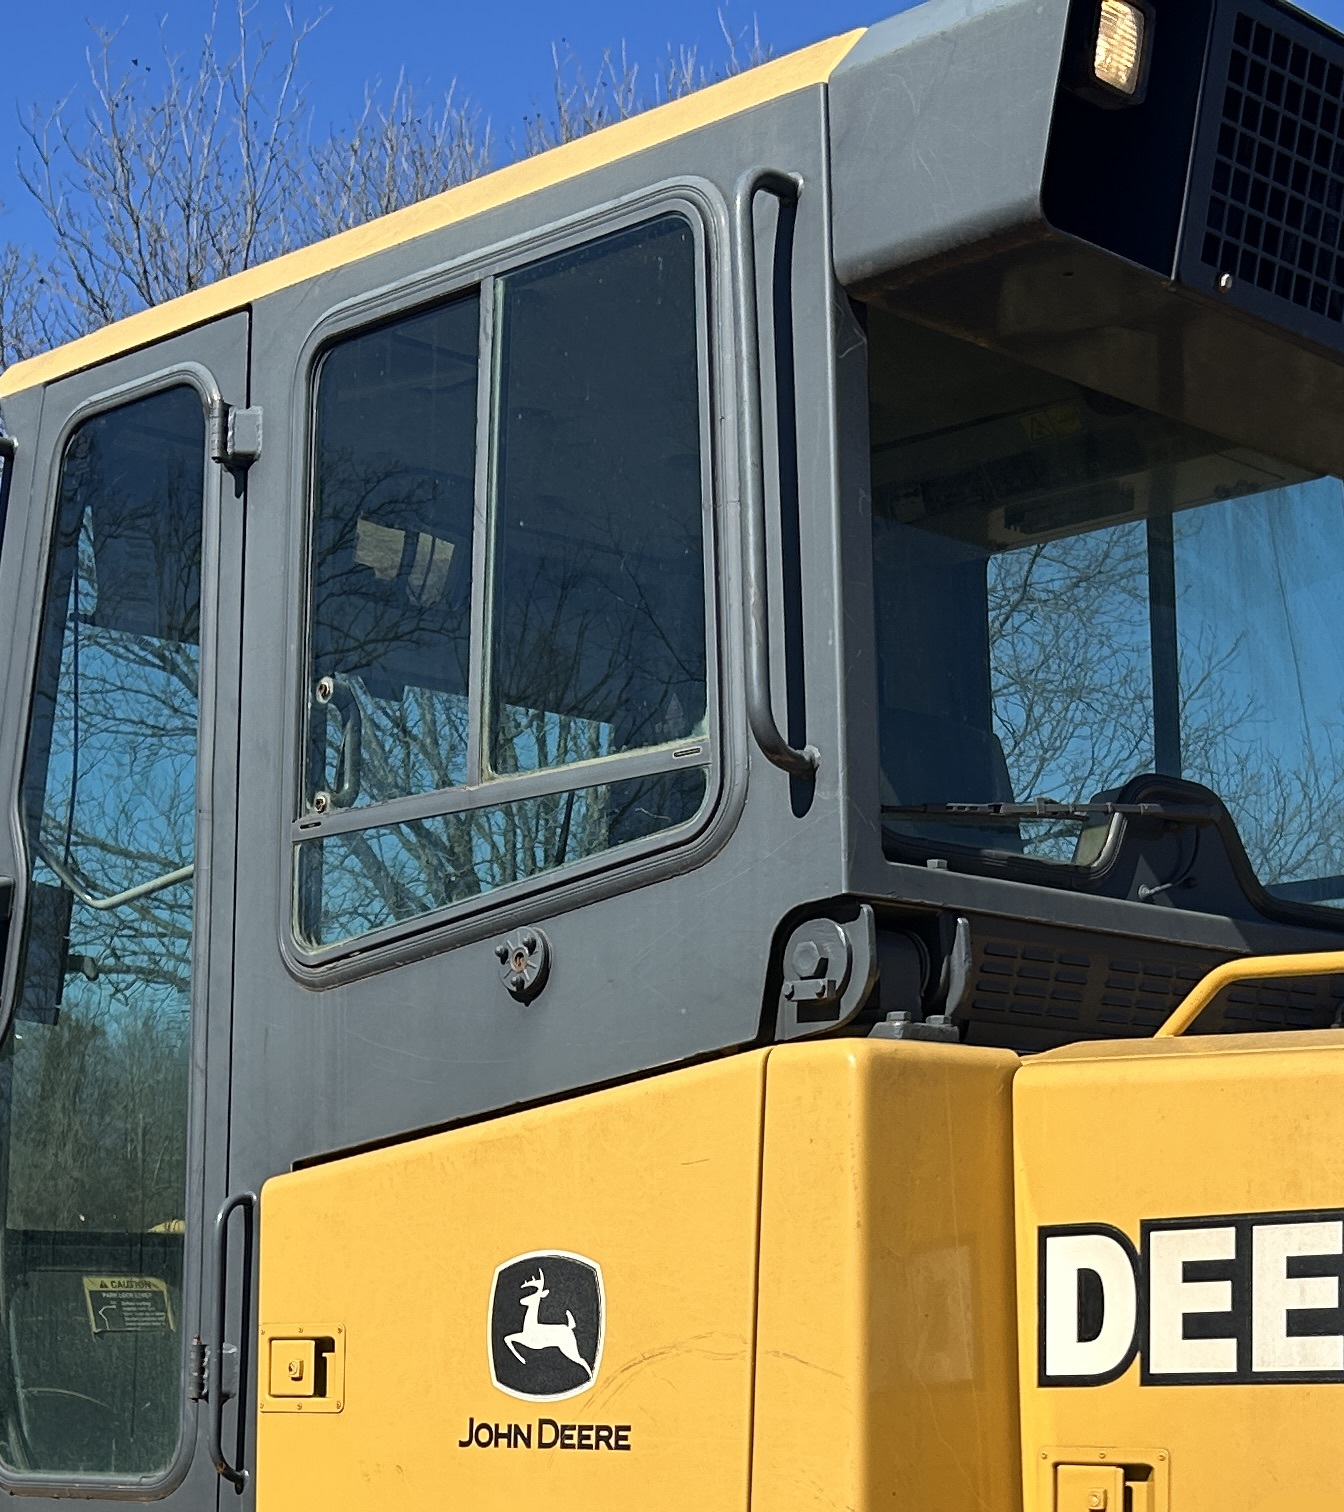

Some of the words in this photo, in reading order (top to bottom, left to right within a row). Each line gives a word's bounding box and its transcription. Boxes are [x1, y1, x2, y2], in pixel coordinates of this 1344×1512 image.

[110, 1281, 152, 1289] CAUTION
[458, 1417, 532, 1449] JOHN
[538, 1418, 632, 1451] DEERE
